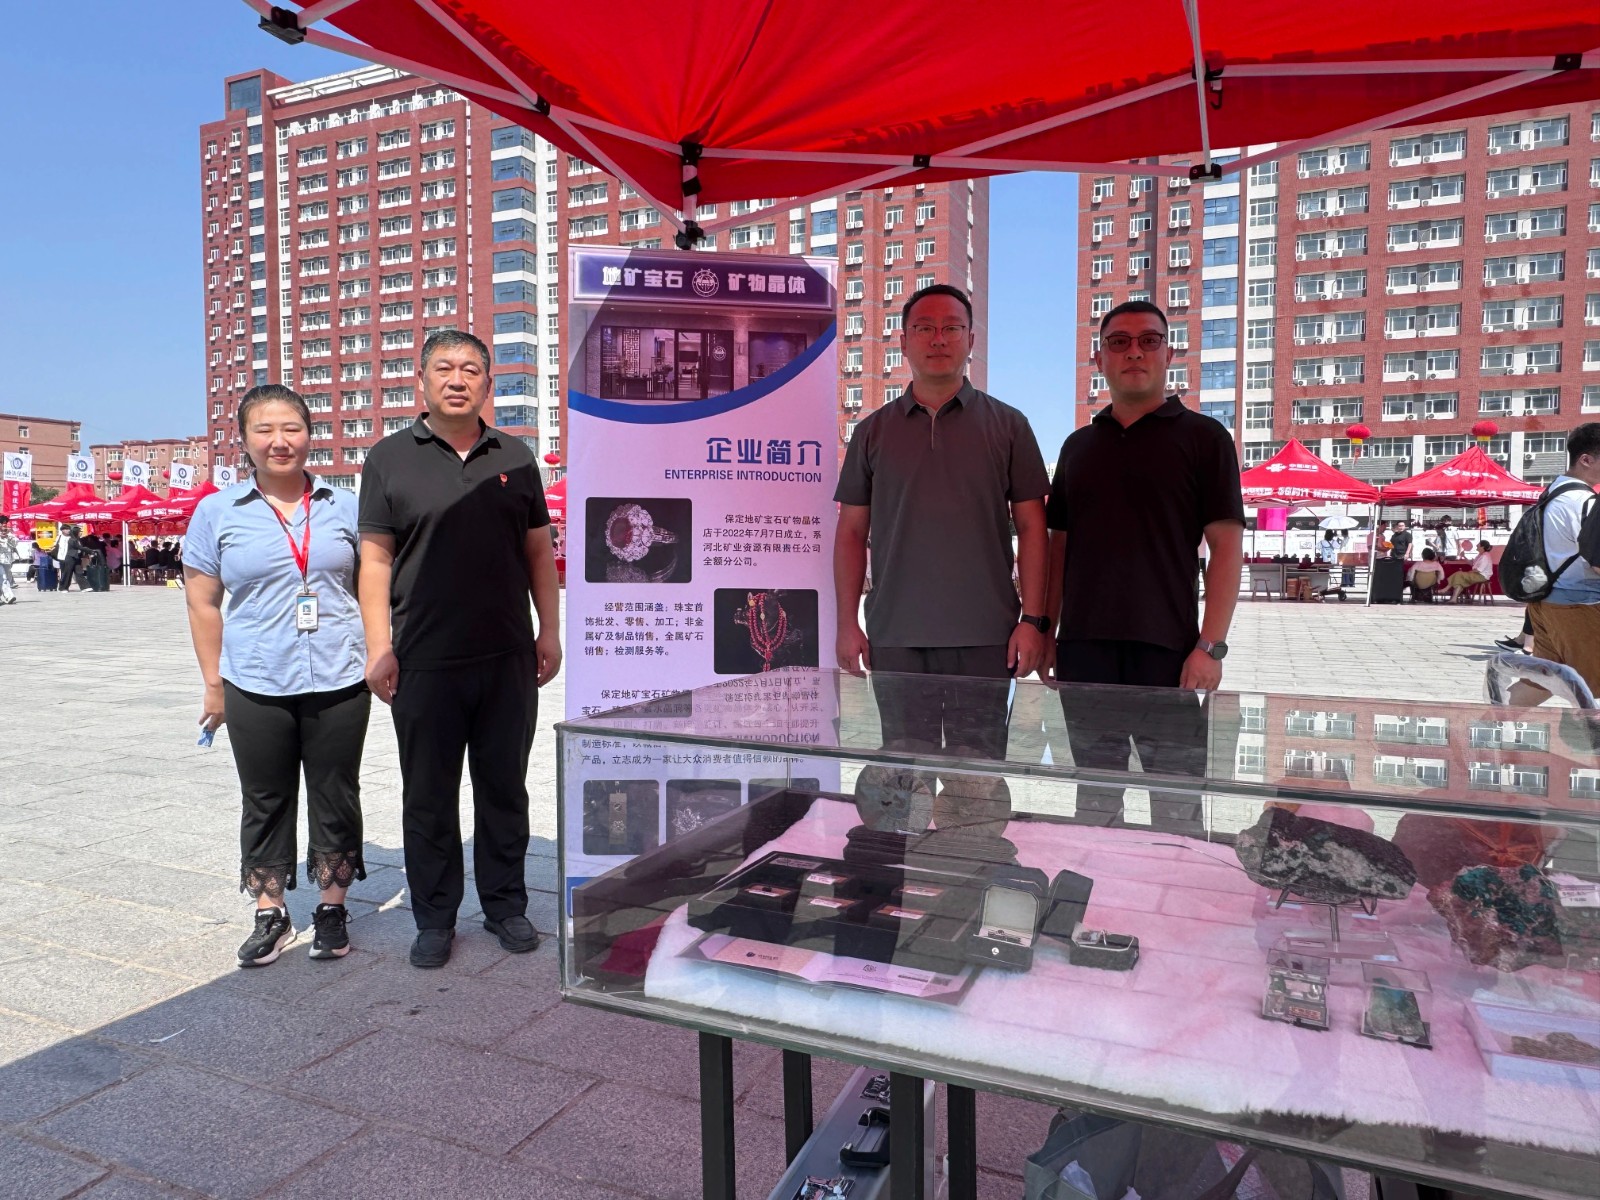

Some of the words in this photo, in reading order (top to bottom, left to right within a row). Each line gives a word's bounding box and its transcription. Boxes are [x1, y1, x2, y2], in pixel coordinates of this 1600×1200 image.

[602, 266, 684, 288] 地矿宝石
[728, 273, 806, 294] 矿物晶体
[706, 437, 822, 466] 企业简介
[665, 469, 733, 480] ENTERPRISE
[736, 471, 822, 483] INTRODUCTION
[725, 514, 821, 525] 保定地矿宝石矿物晶体
[703, 542, 821, 553] 河北矿业资源有限责任公司
[703, 556, 758, 567] 全额分公司。
